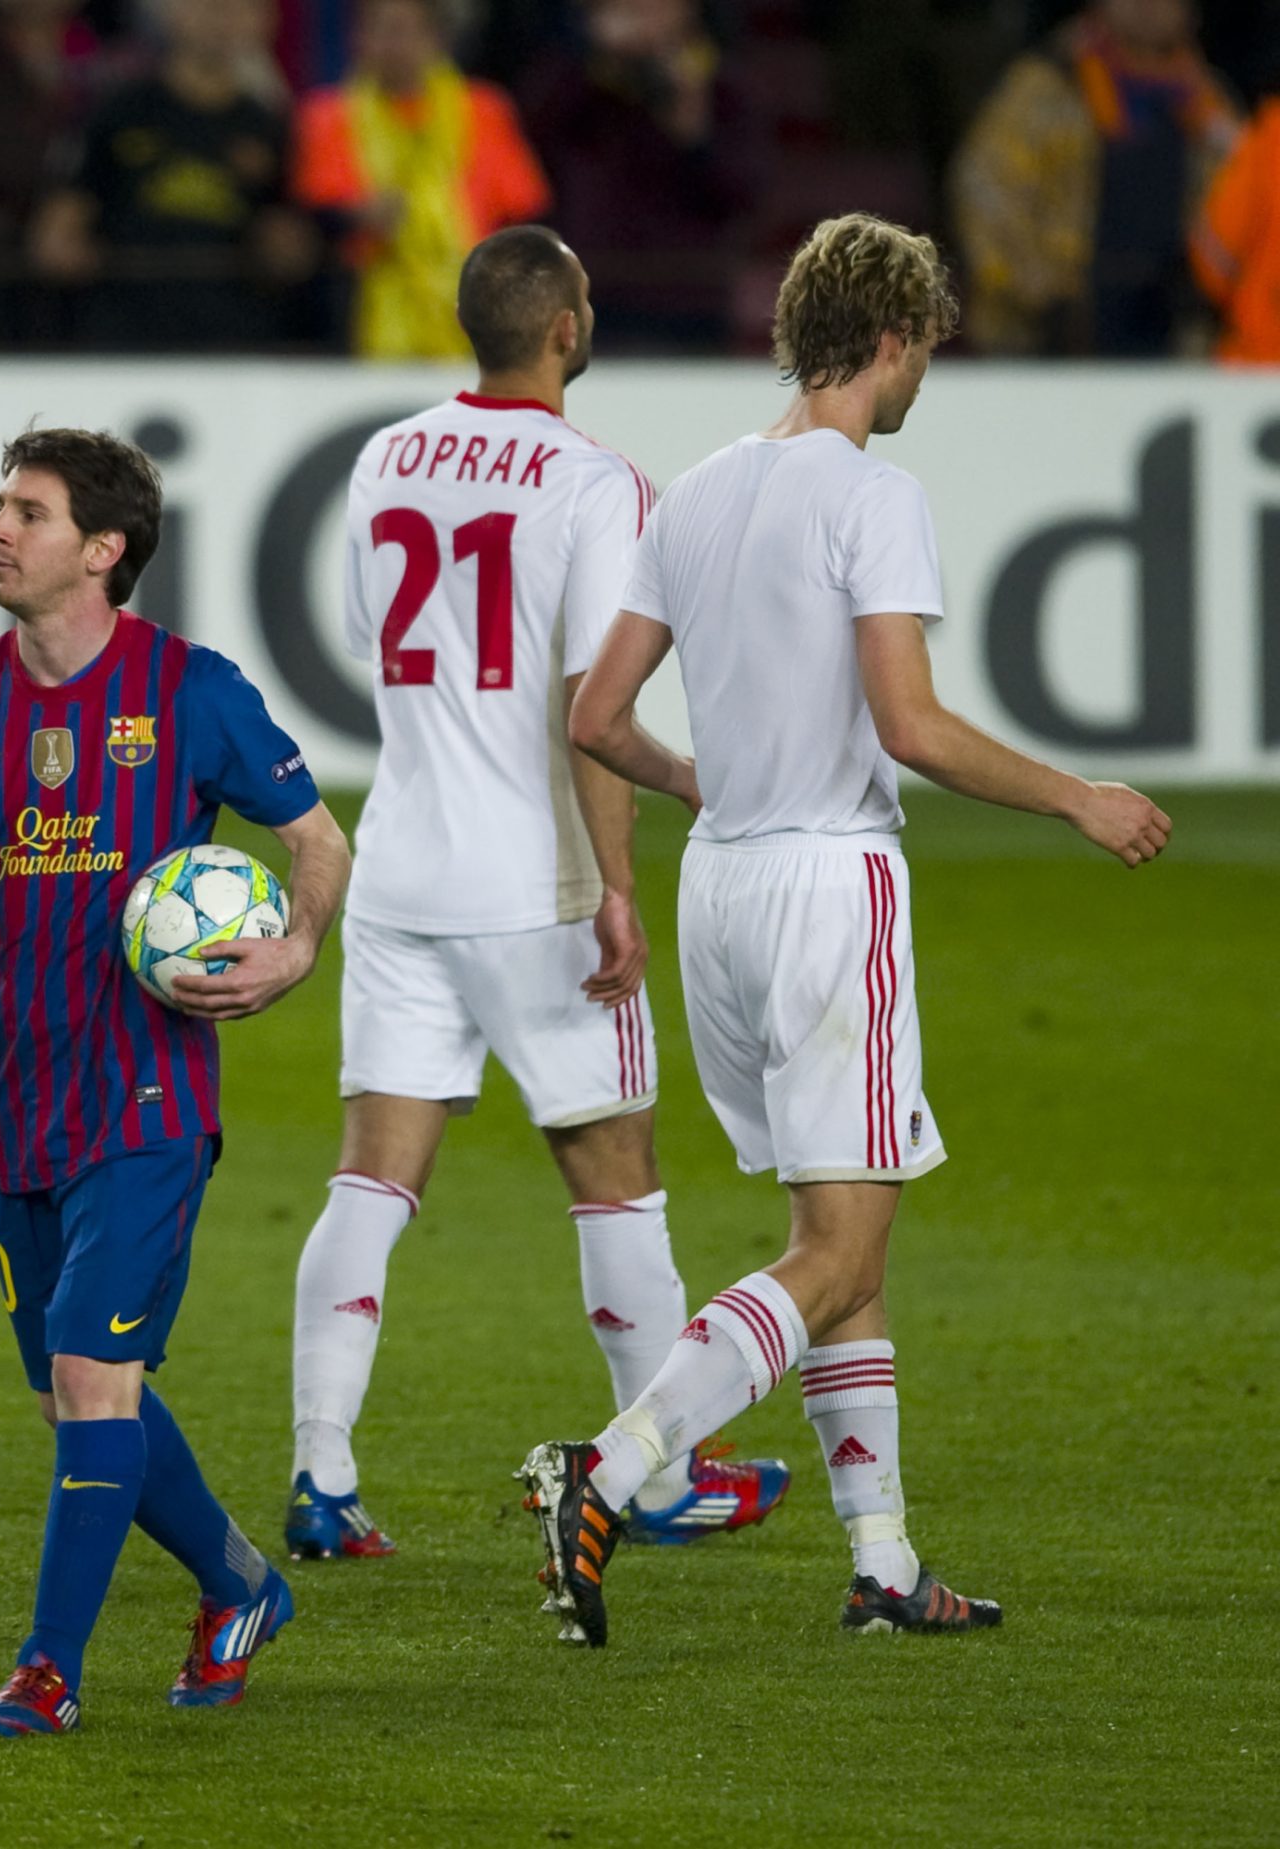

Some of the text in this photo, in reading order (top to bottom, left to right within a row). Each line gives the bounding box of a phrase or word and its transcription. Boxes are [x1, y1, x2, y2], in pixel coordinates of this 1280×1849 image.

[378, 430, 561, 488] TOPRAK
[370, 507, 518, 691] 21
[16, 806, 100, 851] Qatar
